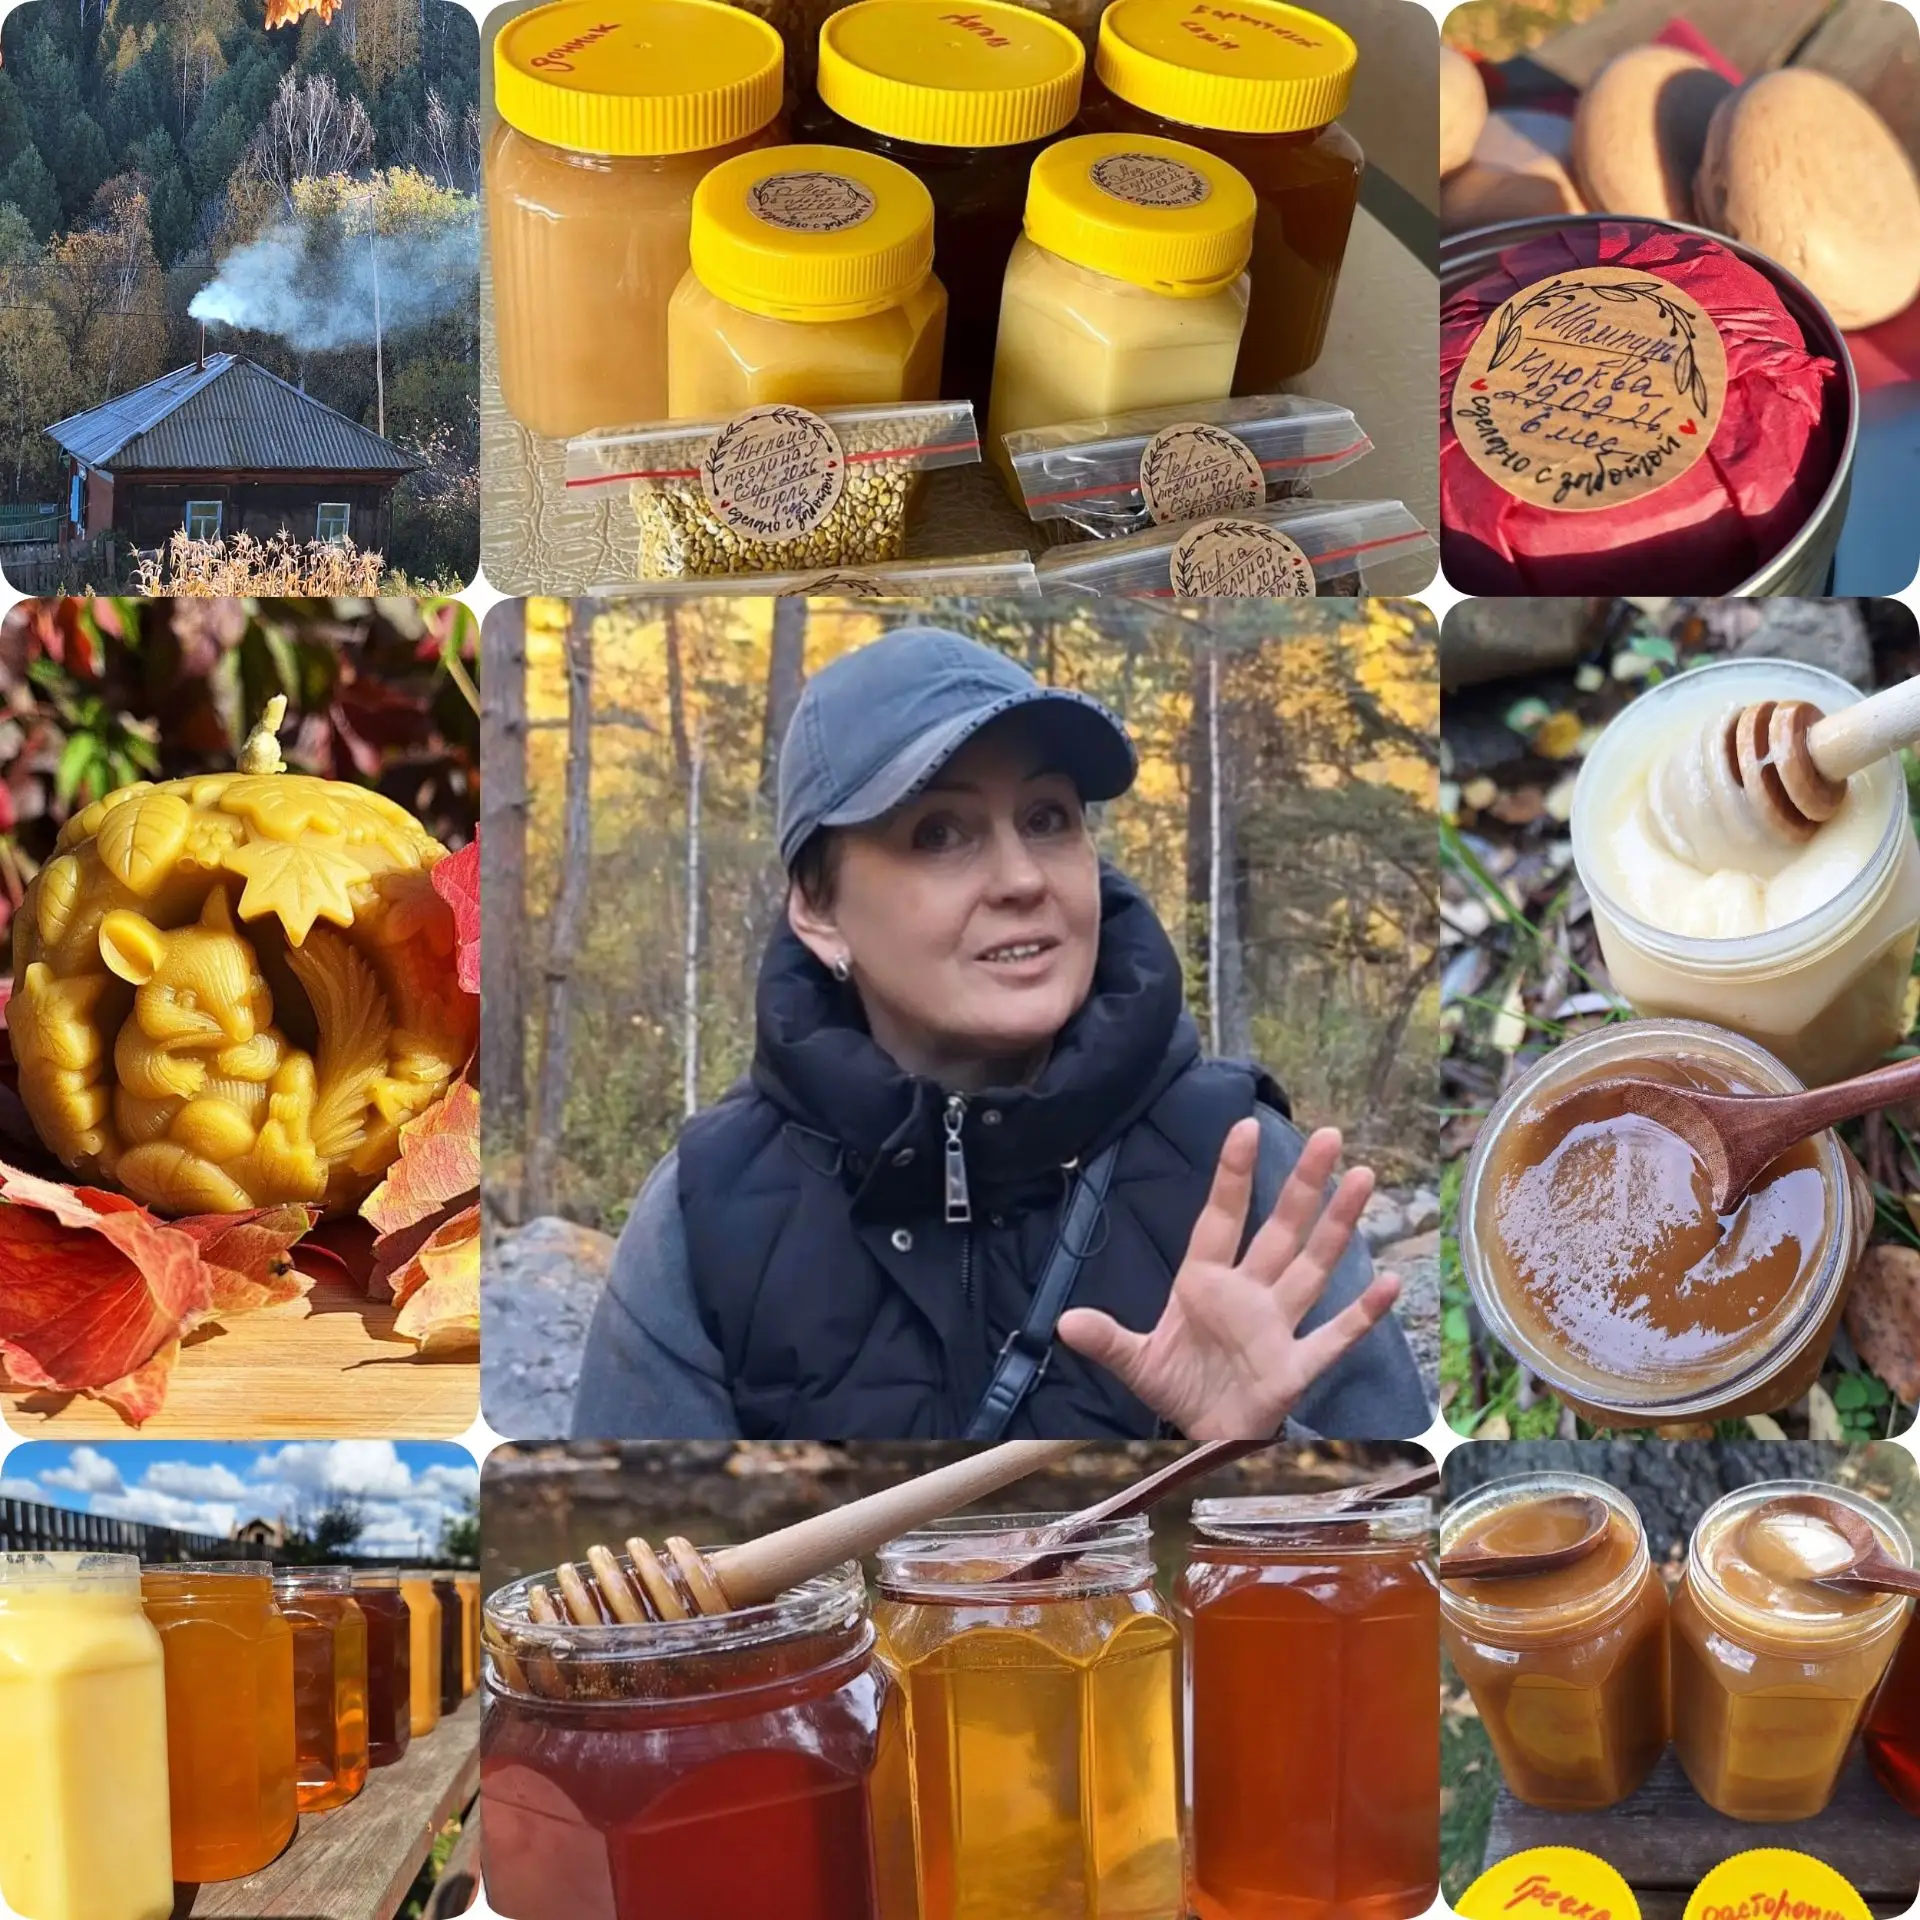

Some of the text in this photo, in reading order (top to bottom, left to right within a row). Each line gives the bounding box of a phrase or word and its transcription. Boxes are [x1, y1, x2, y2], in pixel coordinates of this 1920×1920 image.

[1520, 412, 1551, 433] 6
[1457, 395, 1682, 503] сделано с заботой
[728, 507, 780, 533] сделано
[786, 518, 794, 529] с
